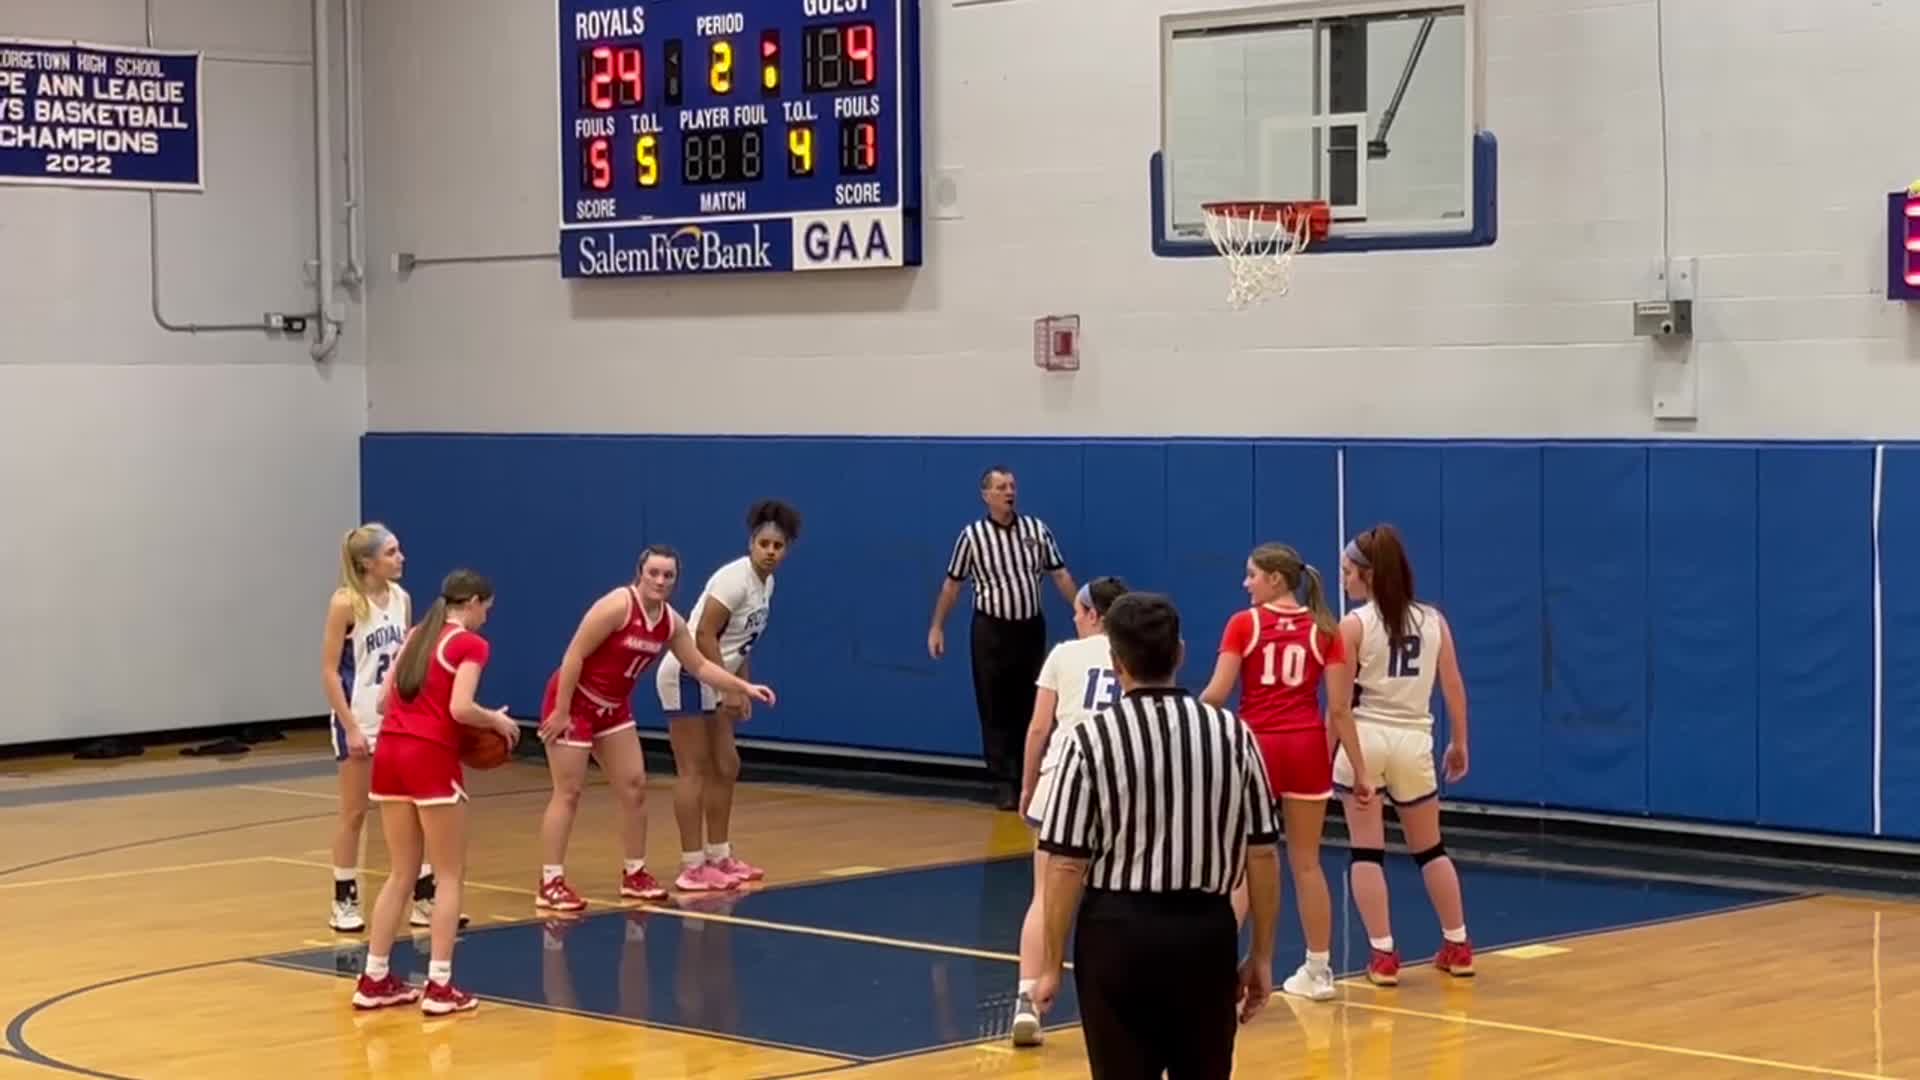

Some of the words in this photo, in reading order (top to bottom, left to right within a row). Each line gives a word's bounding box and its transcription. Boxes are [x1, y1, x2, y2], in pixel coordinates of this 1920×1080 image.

[576, 6, 645, 40] ROYALS
[697, 13, 744, 36] PERIOD
[0, 50, 70, 71] ORGETOWN
[77, 53, 107, 74] HIGH
[115, 56, 164, 77] SCHOOL
[711, 41, 732, 93] 2
[847, 25, 874, 82] 4
[37, 74, 84, 97] ANN
[93, 78, 184, 102] LEAGUE
[591, 48, 642, 109] 24
[34, 99, 188, 129] BASKETBALL
[680, 106, 729, 130] PLAYER
[734, 104, 768, 125] FOUL
[834, 95, 880, 118] FOULS
[0, 125, 159, 154] CHAMPIONS
[575, 116, 615, 138] FOULS
[46, 154, 112, 174] 2022
[590, 139, 611, 189] 5
[636, 136, 657, 185] 5
[789, 128, 811, 171] 4
[576, 198, 616, 219] SCORE
[700, 191, 746, 211] MATCH
[835, 182, 881, 205] SCORE
[804, 221, 891, 262] GAA
[1261, 643, 1306, 687] 10
[1387, 635, 1422, 678] 12
[1083, 668, 1121, 711] 13
